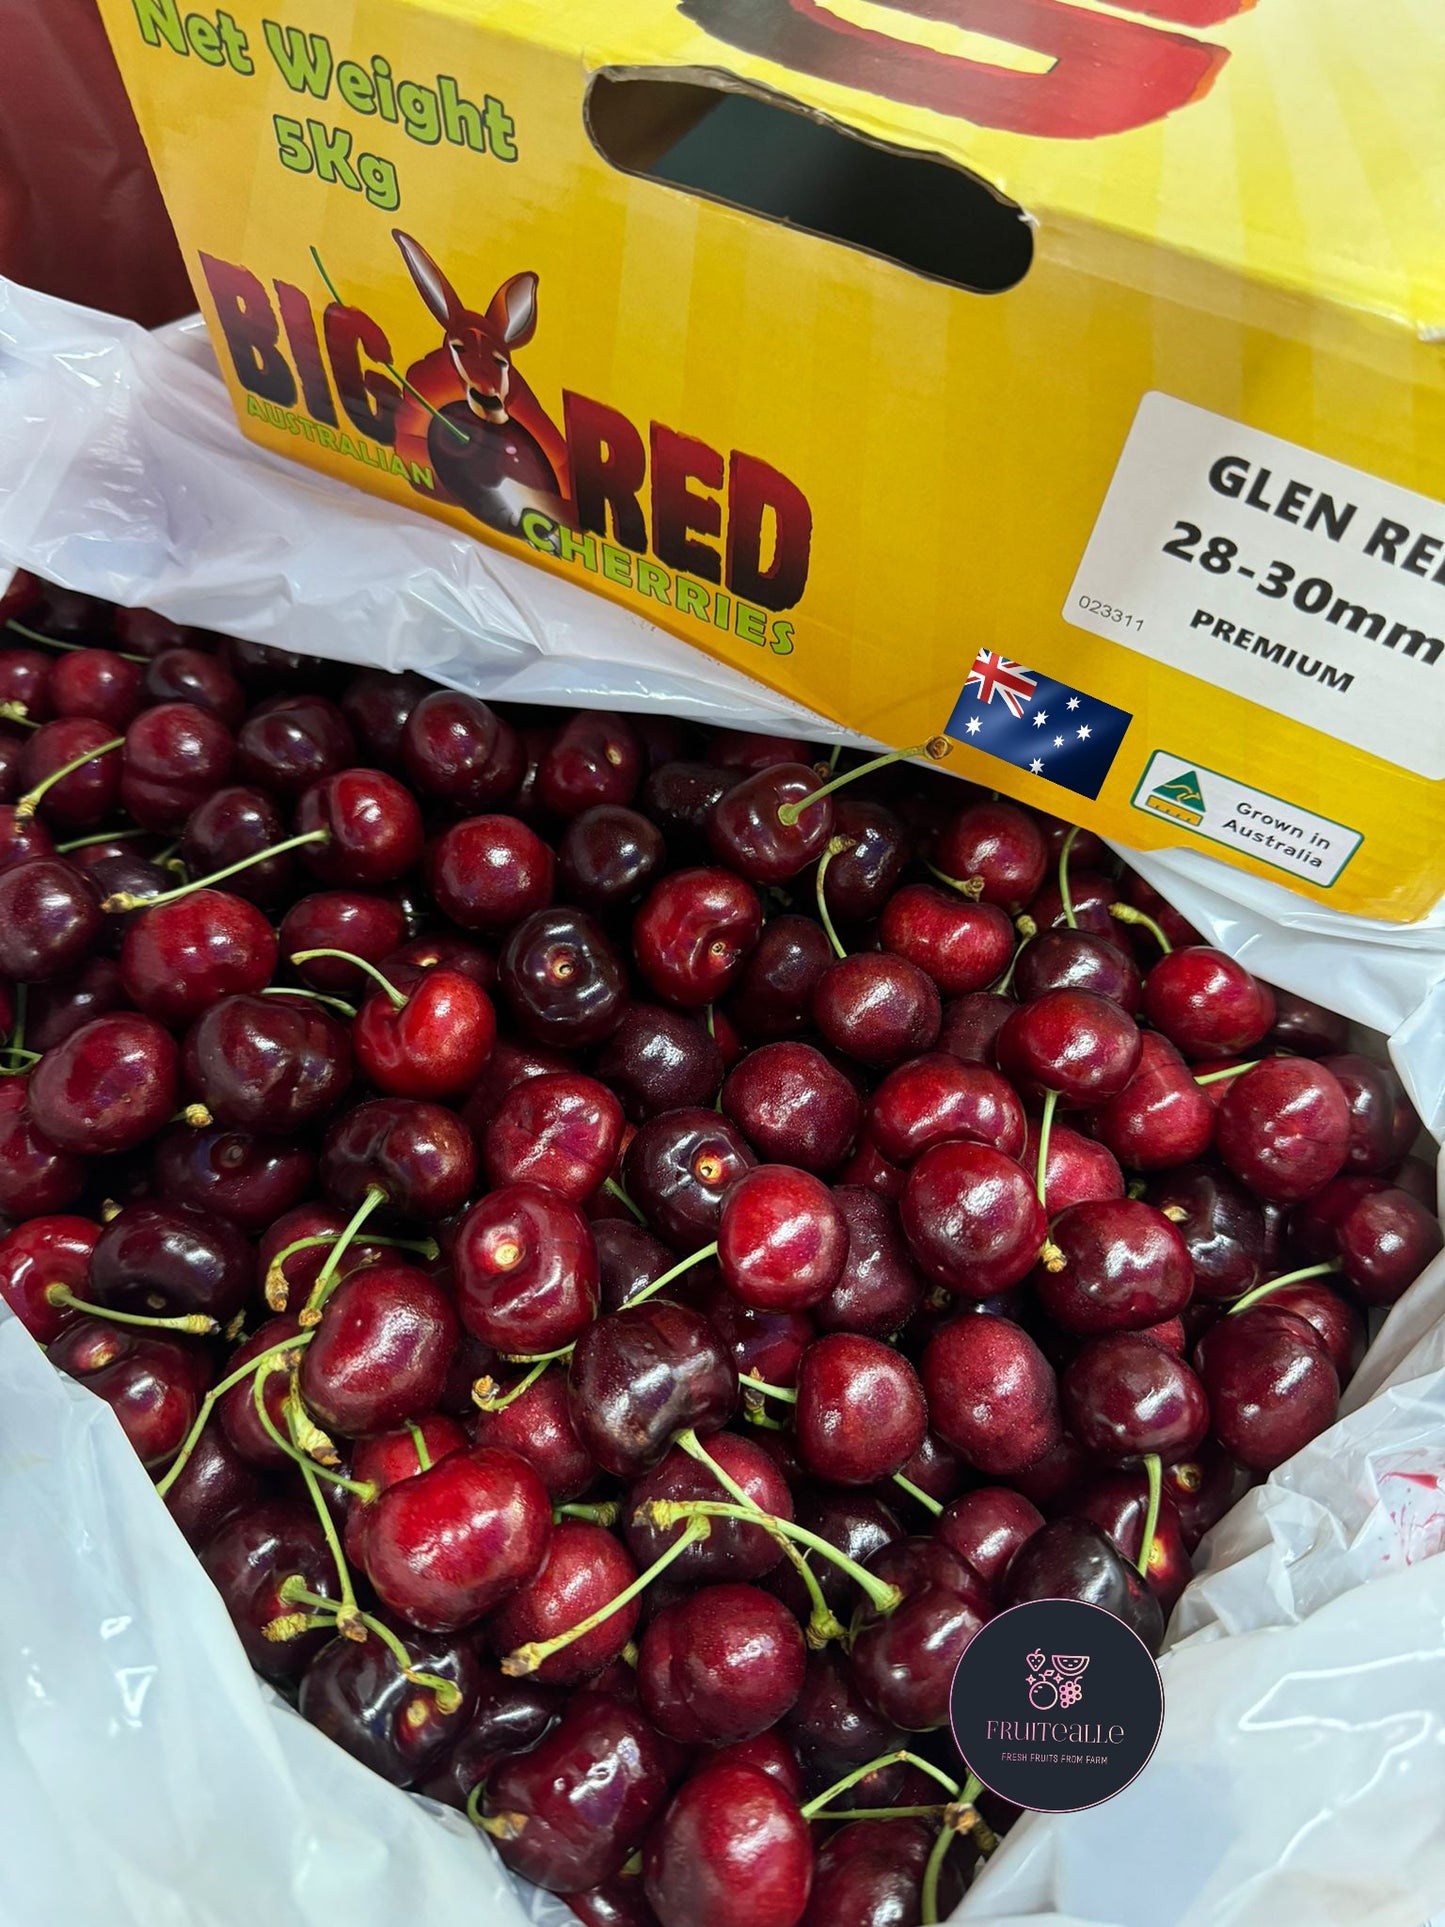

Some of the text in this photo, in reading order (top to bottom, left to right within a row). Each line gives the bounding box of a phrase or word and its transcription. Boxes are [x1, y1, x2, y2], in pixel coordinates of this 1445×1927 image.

[132, 0, 518, 163] Net Weight
[273, 114, 400, 211] 5Kg
[198, 250, 813, 612] BIG RED
[247, 395, 795, 655] AUSTRALIAN CHERRIES
[1208, 456, 1357, 542] GLEN
[1078, 595, 1144, 632] 023311
[1162, 521, 1445, 666] 28-30mm
[1189, 609, 1355, 693] PREMIUM
[1222, 819, 1322, 868] Australia
[1236, 802, 1331, 850] Grown in
